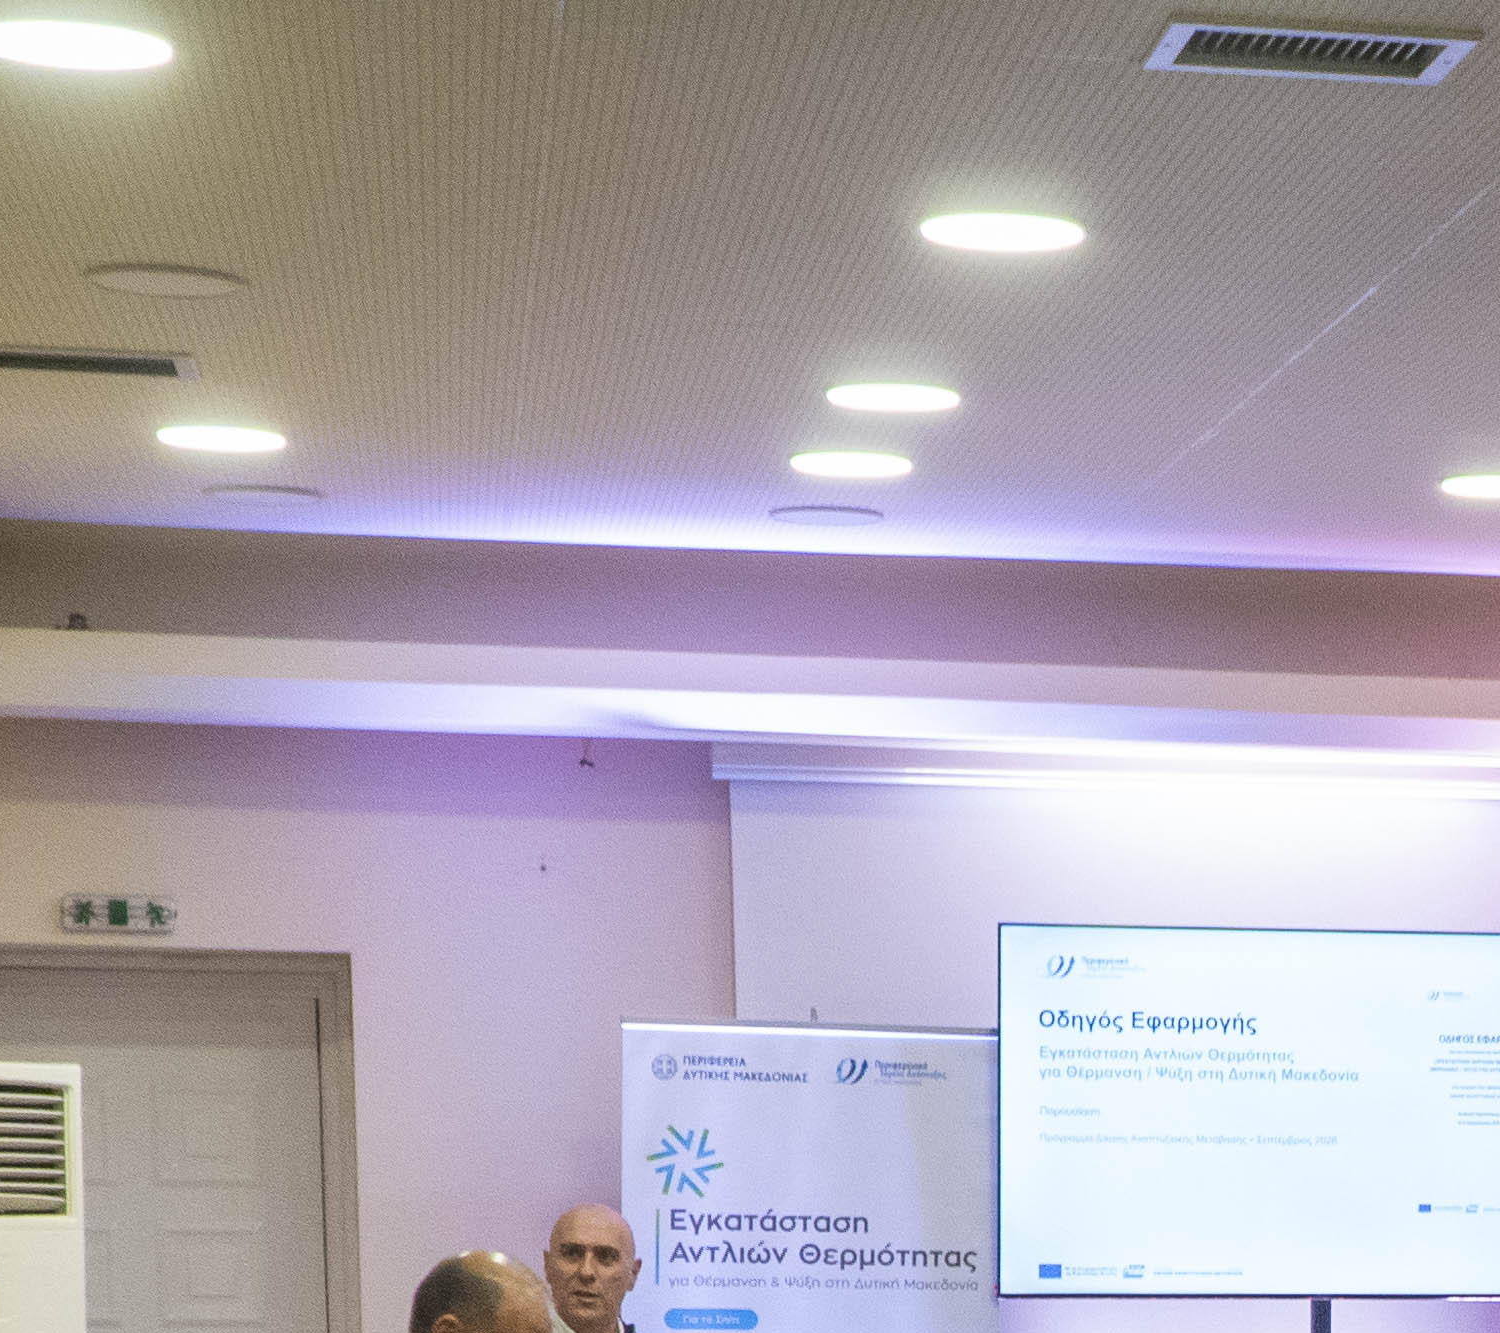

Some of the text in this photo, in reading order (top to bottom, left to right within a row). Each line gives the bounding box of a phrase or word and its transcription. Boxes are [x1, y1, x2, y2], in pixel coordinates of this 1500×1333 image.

[1038, 1009, 1257, 1035] Οδηγός Εφαρμογής
[1039, 1045, 1295, 1064] Εγκατάσταση Αντλιών Θερμότητας
[682, 1070, 809, 1084] ΔΥΤΙΚΗΣ ΜΑΚΕΔΟΝΙΑΣ
[1039, 1067, 1061, 1081] για
[1065, 1065, 1142, 1082] Θέρμανση
[1155, 1066, 1193, 1082] Ψύξη
[1197, 1069, 1224, 1082] στη
[1228, 1067, 1277, 1082] Δυτική
[1280, 1068, 1359, 1083] Μακεδονία
[670, 1208, 869, 1236] Εγκατάσταση
[669, 1240, 978, 1271] Αντλιών Θερμότητας
[668, 1277, 690, 1290] για
[693, 1276, 767, 1290] Θέρμανση
[770, 1277, 780, 1289] &
[825, 1279, 850, 1290] στη
[853, 1277, 900, 1291] Δυτική
[903, 1277, 979, 1292] Μακεδονία
